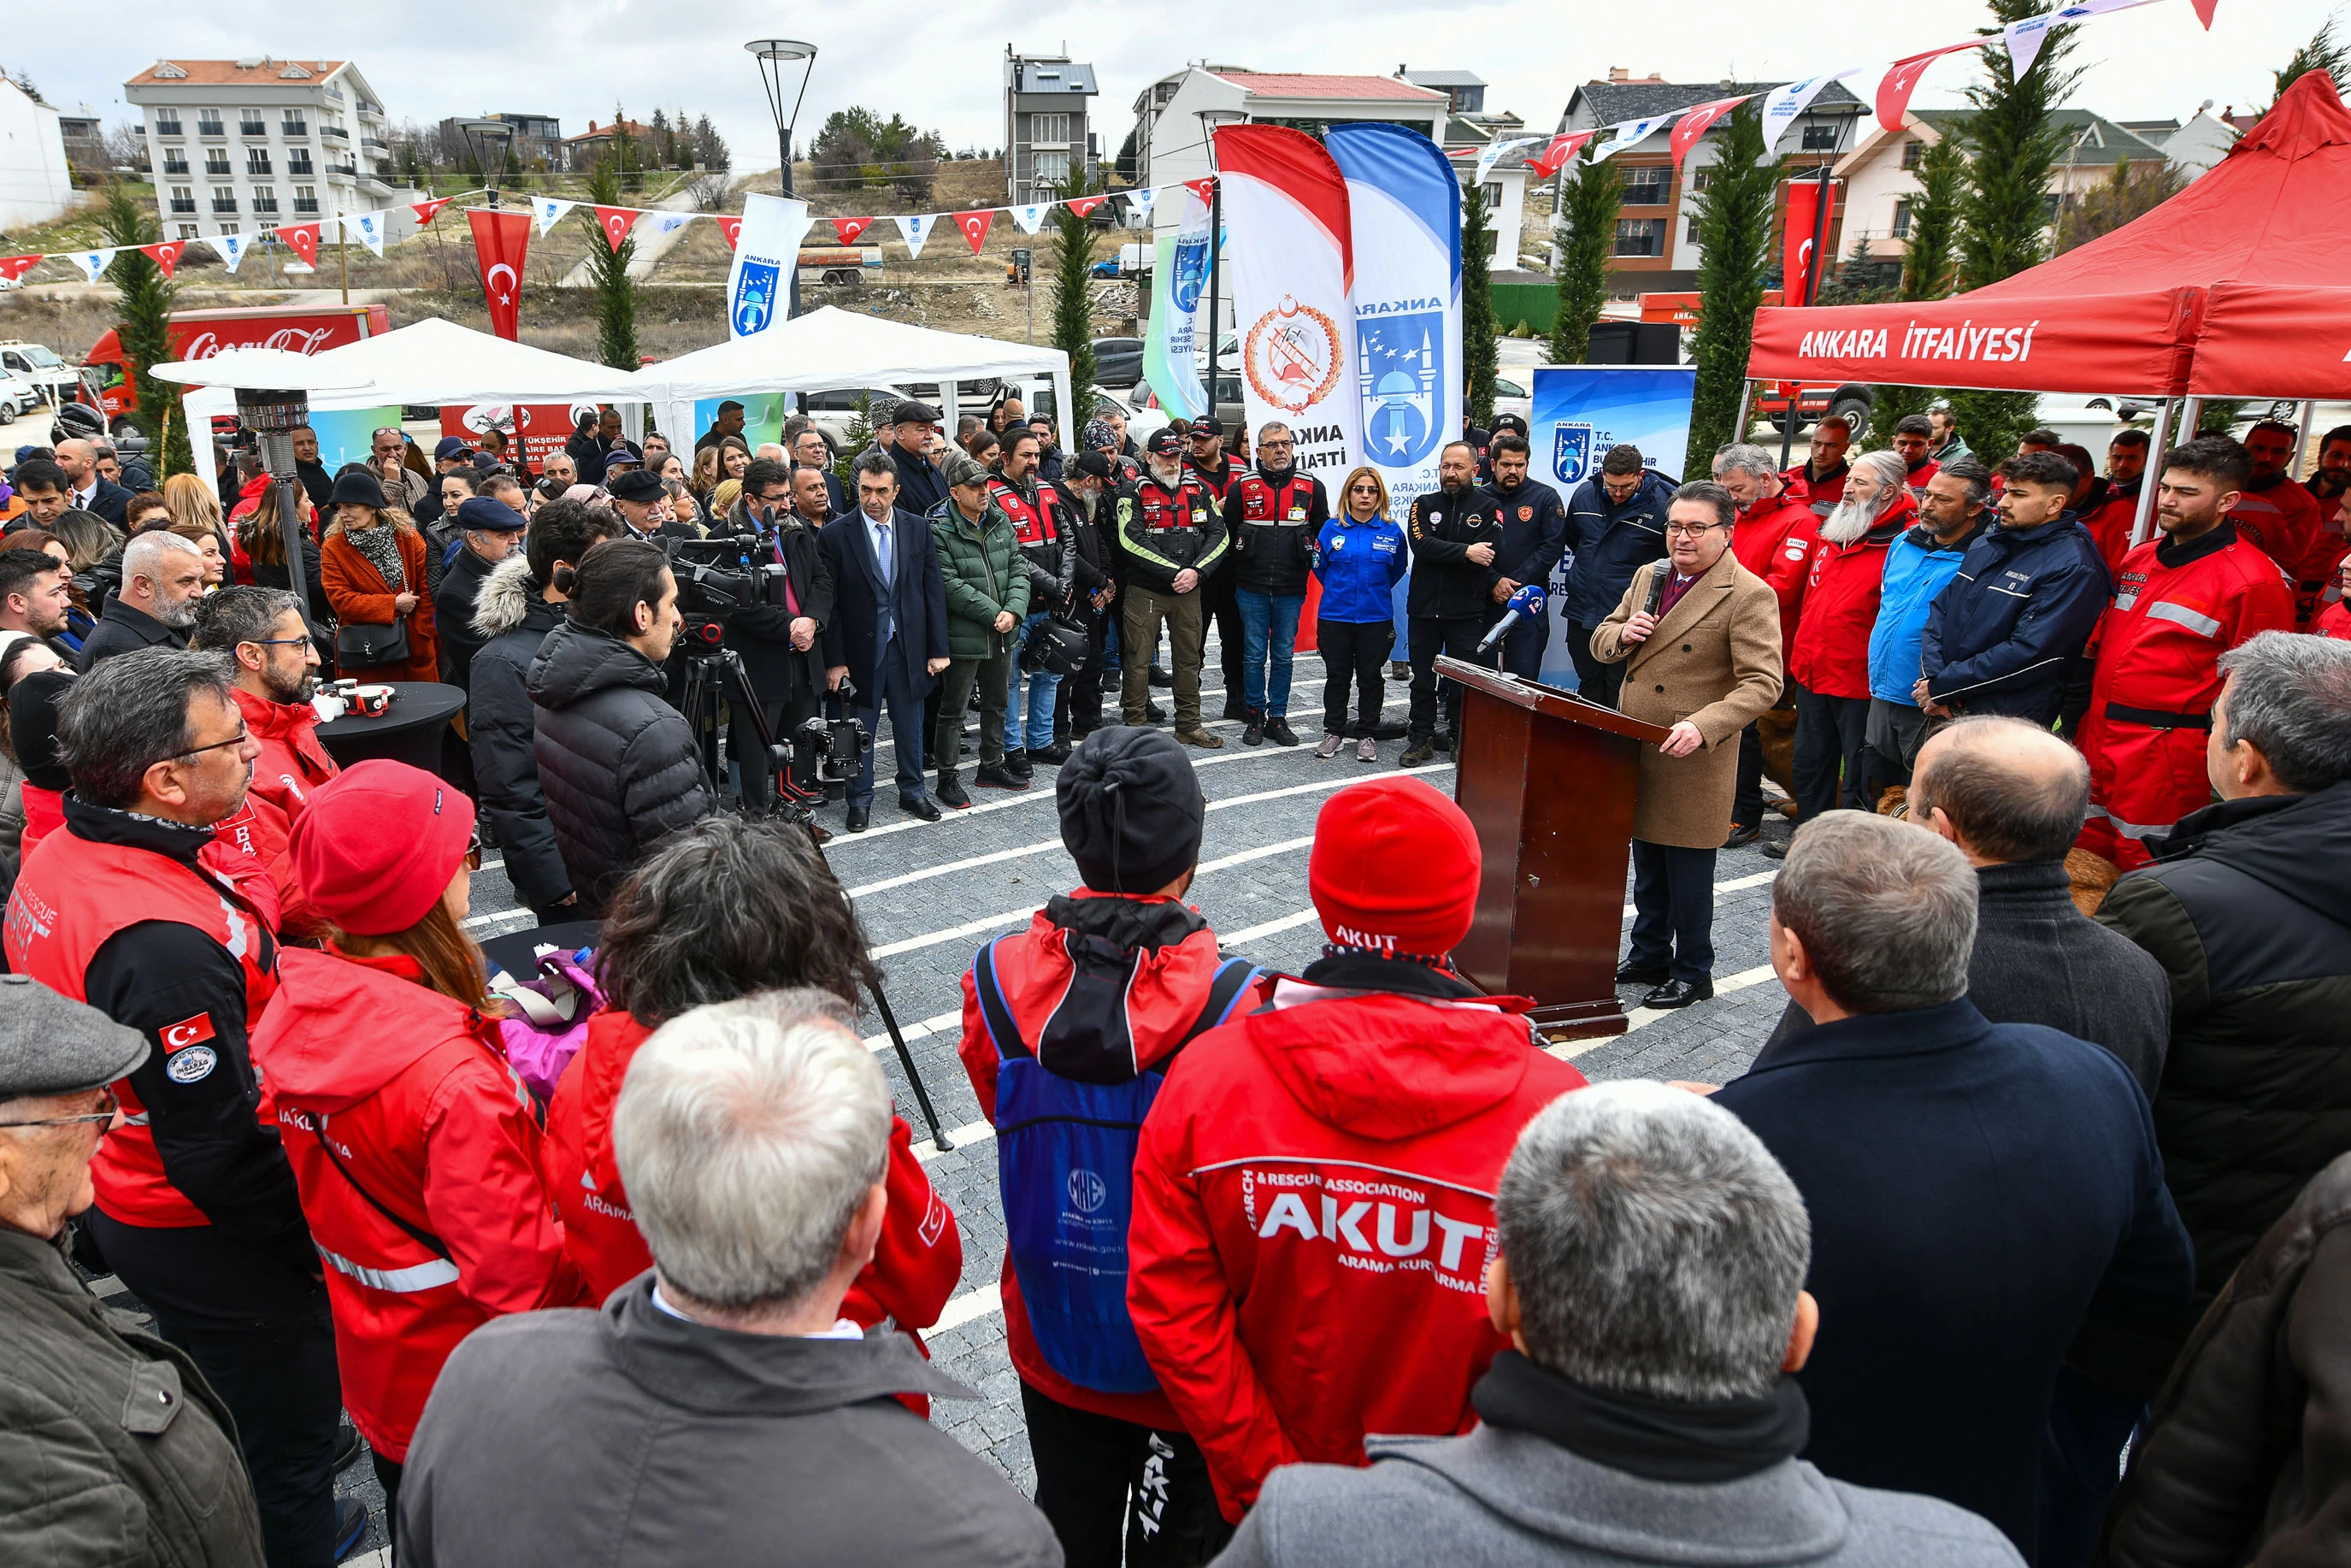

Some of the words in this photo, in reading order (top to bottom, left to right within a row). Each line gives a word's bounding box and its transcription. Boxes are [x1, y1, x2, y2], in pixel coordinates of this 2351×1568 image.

[744, 254, 781, 266] ANKARA
[1799, 329, 1888, 358] ANKARA
[1900, 319, 2041, 362] İTFAİYESİ
[1595, 431, 1613, 440] T.C.
[27, 888, 57, 925] RESCUE
[1336, 924, 1398, 951] AKUT
[1257, 1171, 1266, 1184] &
[1268, 1173, 1323, 1187] RESCUE
[1325, 1178, 1425, 1205] ASSOCIATION
[1258, 1193, 1483, 1272] AKUT
[1338, 1253, 1394, 1273] ARAMA
